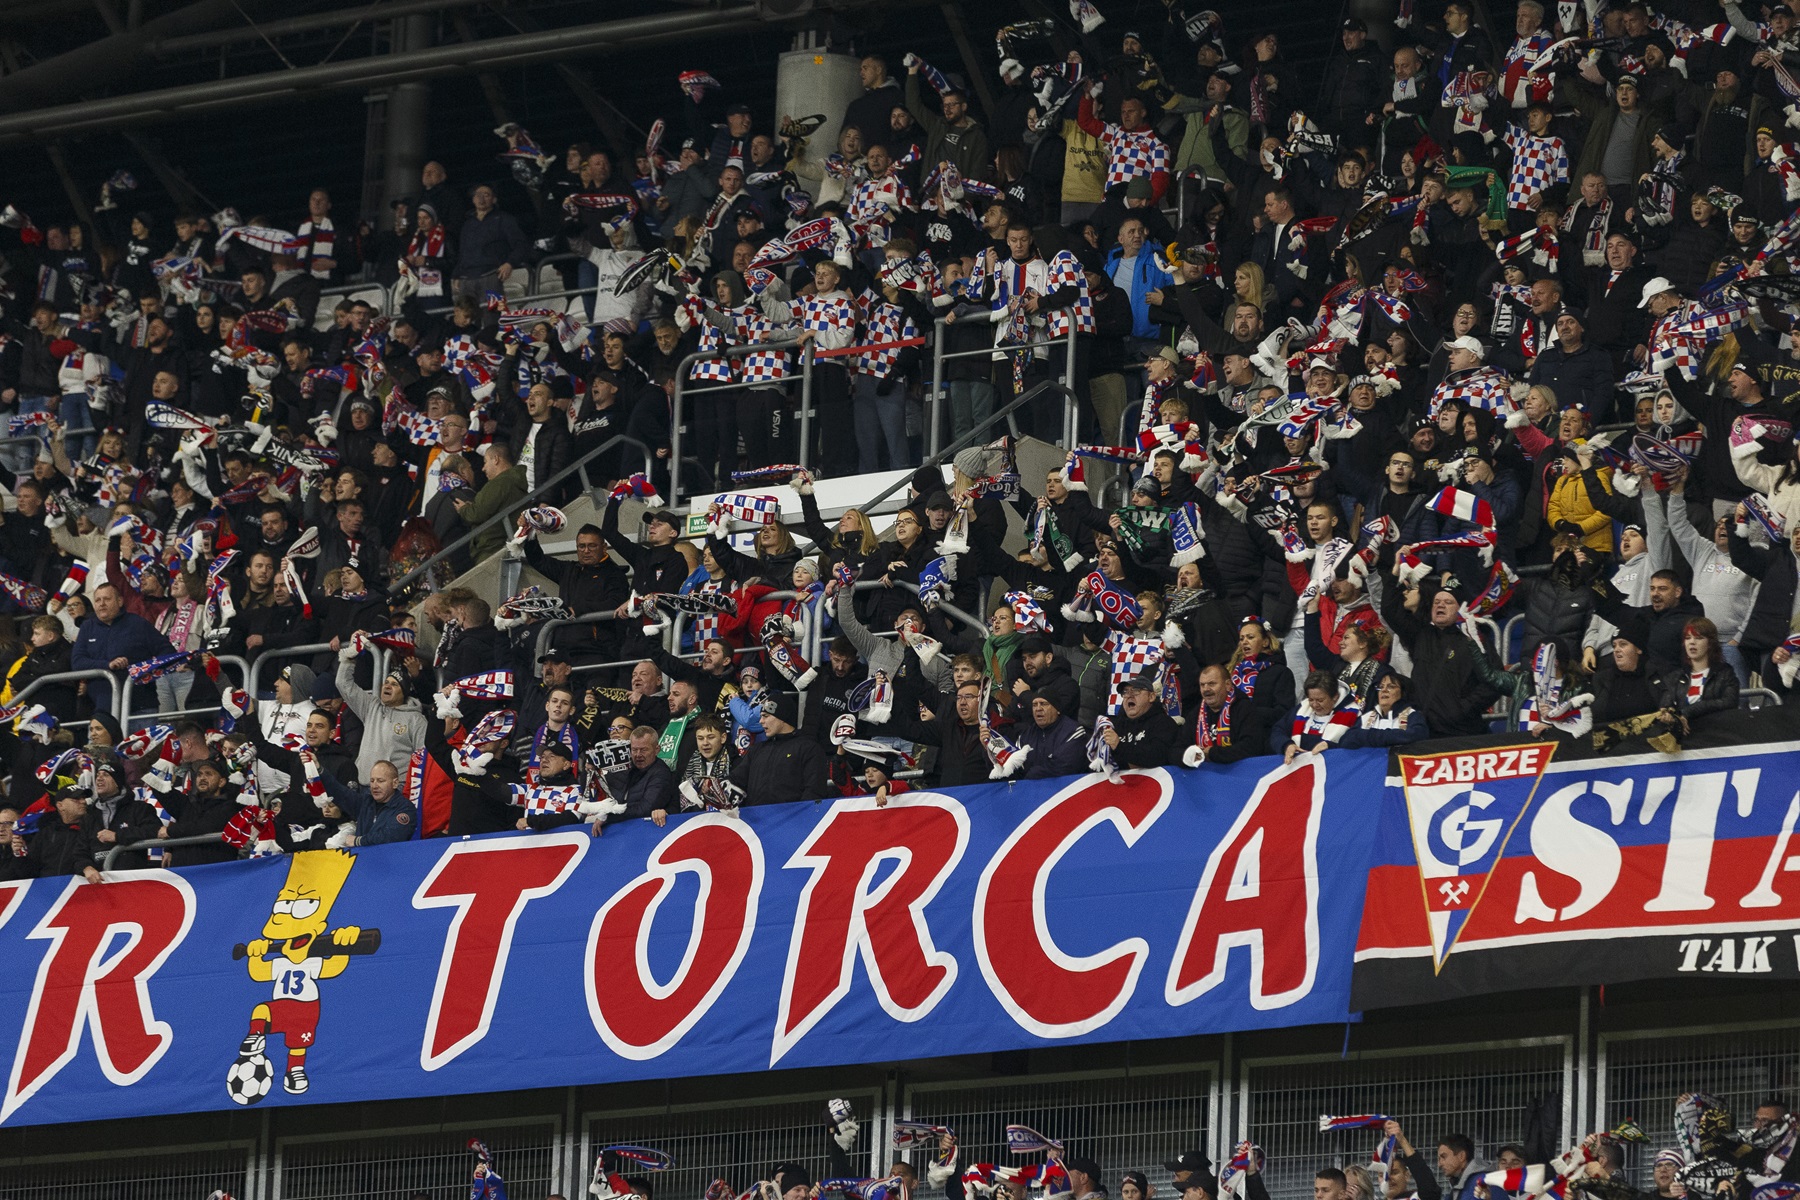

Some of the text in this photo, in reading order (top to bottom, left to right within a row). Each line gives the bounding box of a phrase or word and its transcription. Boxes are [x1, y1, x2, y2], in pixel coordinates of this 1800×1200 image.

[1411, 748, 1540, 785] ZABRZE
[0, 751, 1328, 1125] R TORCA
[1677, 936, 1777, 973] TAK
[281, 970, 304, 995] 13
